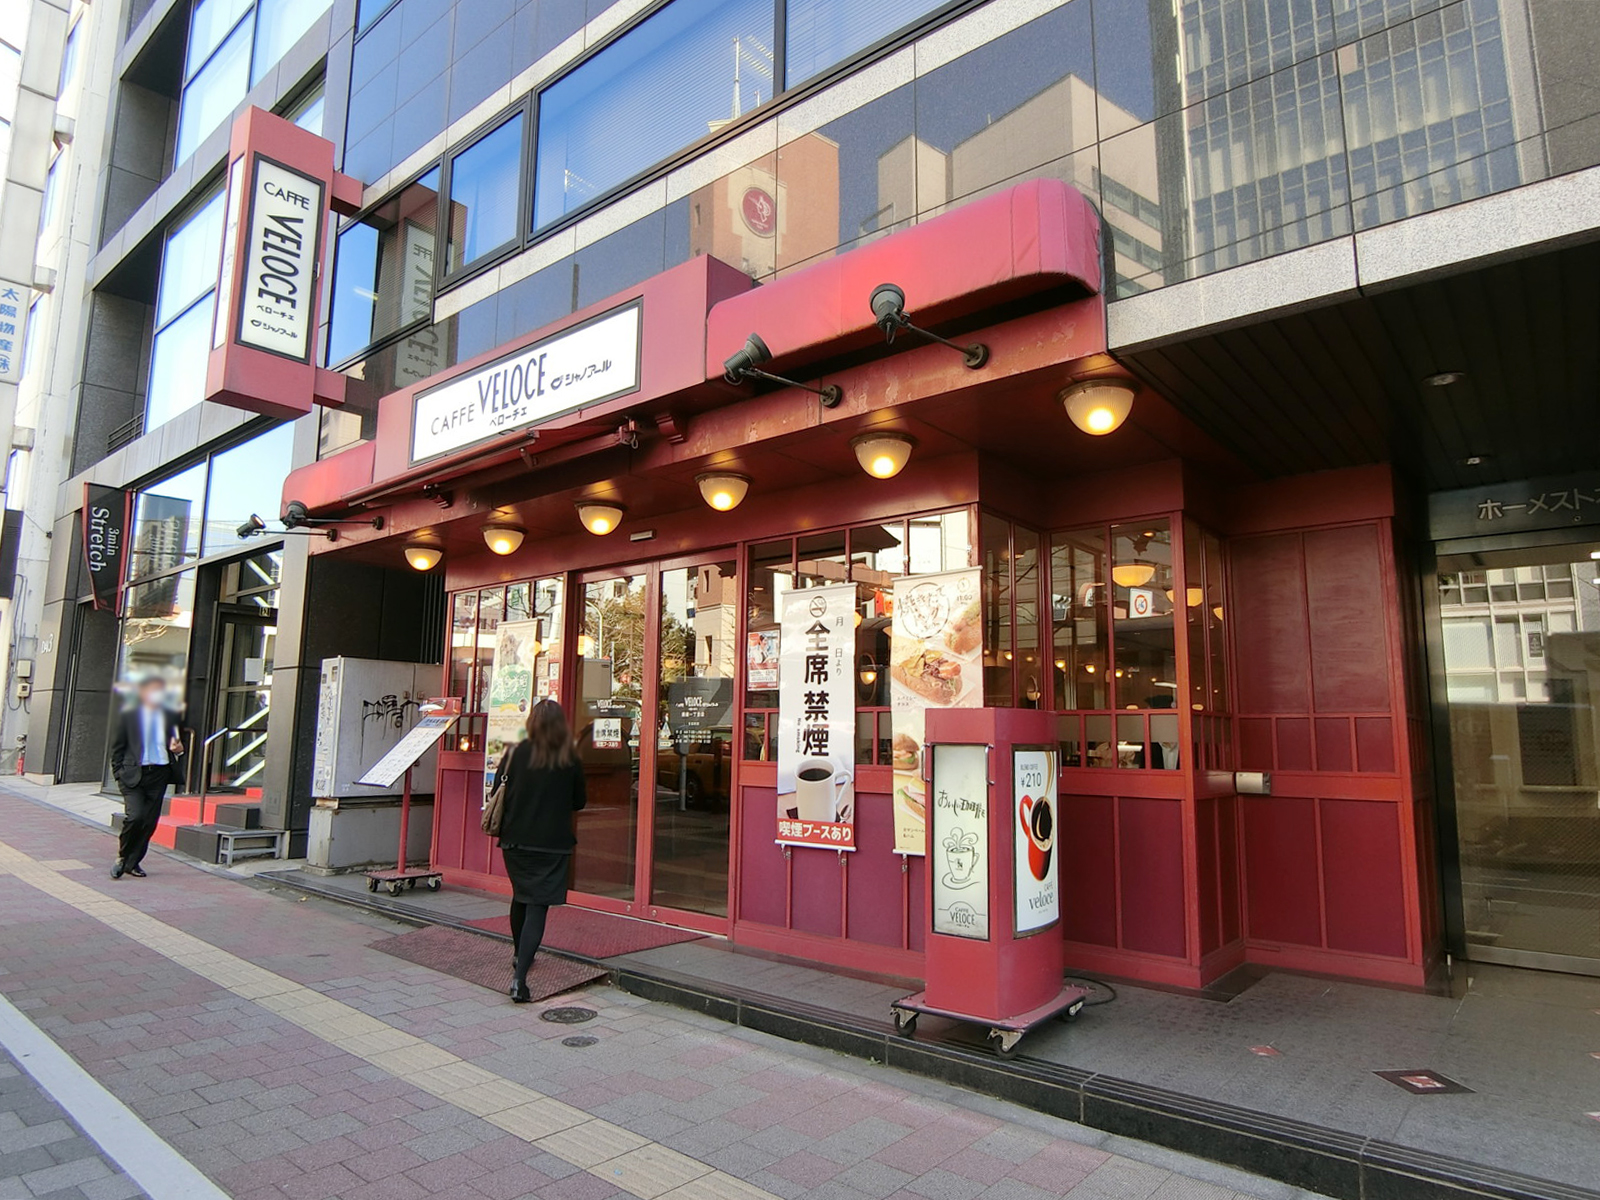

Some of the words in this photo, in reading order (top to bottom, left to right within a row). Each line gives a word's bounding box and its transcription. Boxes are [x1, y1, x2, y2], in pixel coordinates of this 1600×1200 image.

[263, 181, 310, 211] CAFFE
[257, 213, 304, 310] VELOCE
[564, 359, 612, 387] シャノアール
[430, 402, 475, 436] CAFFE
[478, 352, 547, 415] VELOCE
[489, 406, 528, 427] ベローチェ
[90, 506, 109, 572] Stretch
[108, 527, 120, 556] 3min
[834, 647, 843, 676] 日より
[802, 620, 830, 757] 全席禁煙
[1021, 772, 1042, 788] ¥210
[779, 820, 852, 842] 喫煙ブースあり
[949, 911, 976, 925] VELOCE
